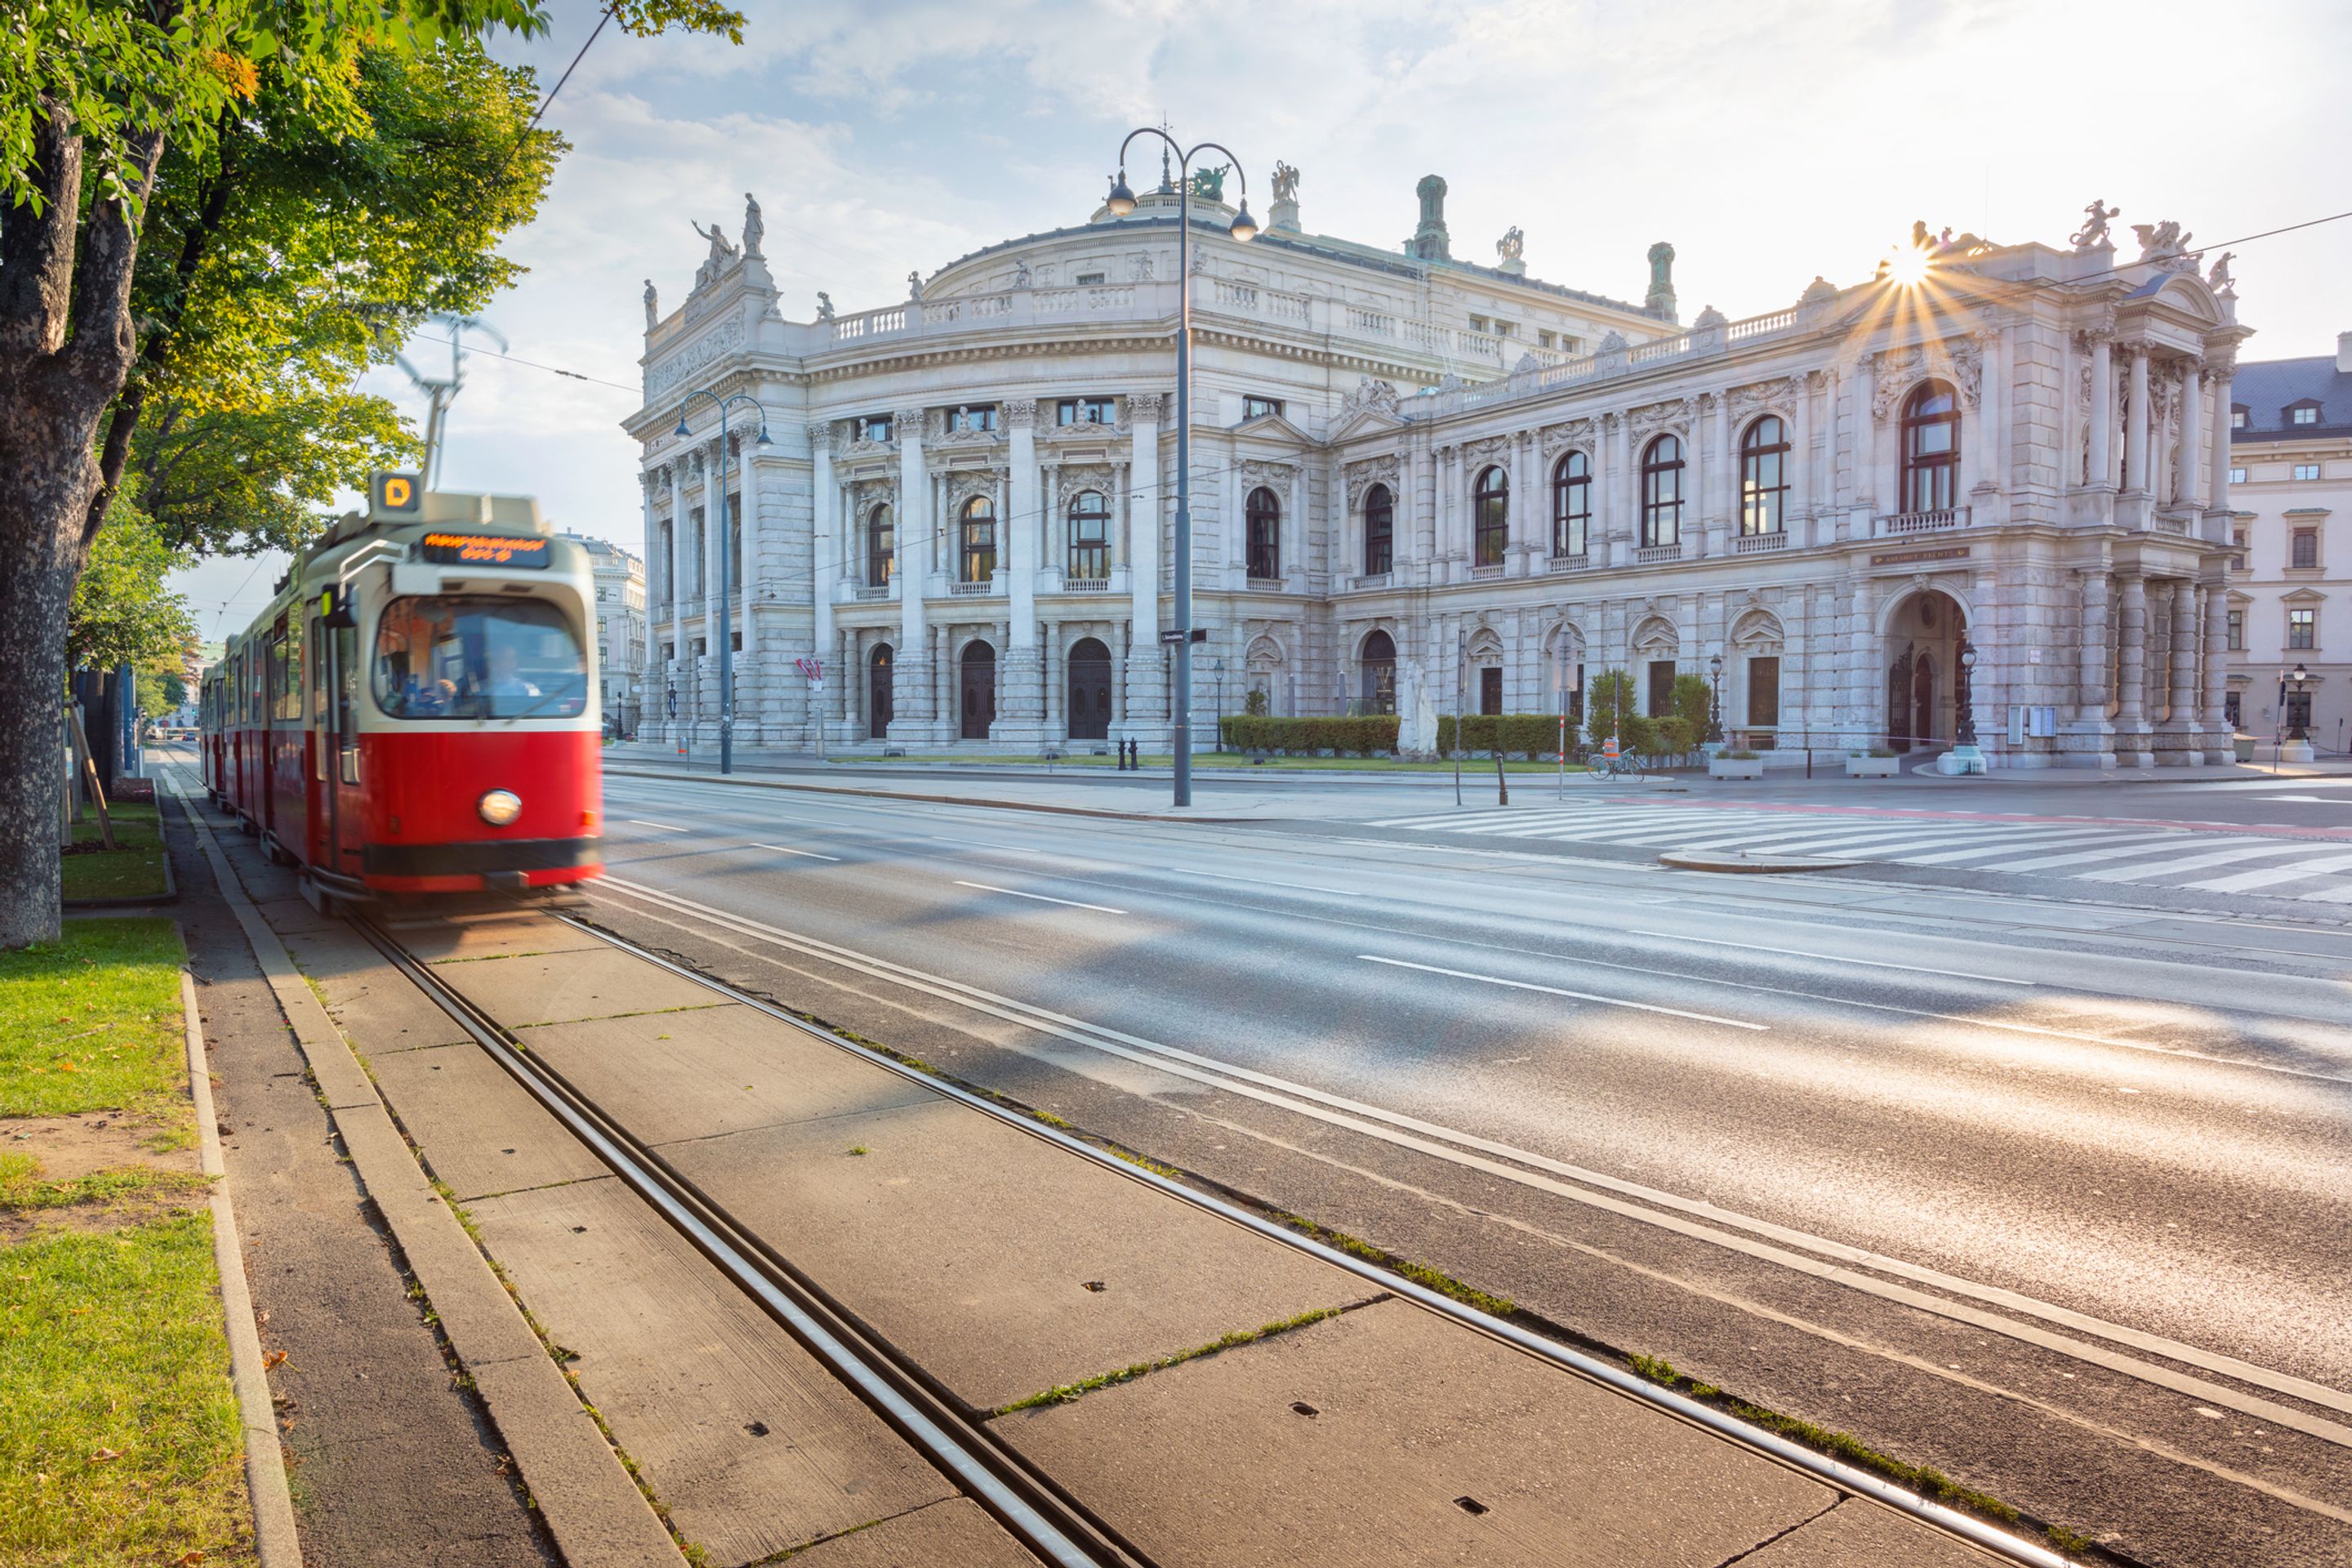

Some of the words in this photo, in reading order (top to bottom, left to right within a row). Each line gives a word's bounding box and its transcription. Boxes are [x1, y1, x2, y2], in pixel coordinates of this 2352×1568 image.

[385, 478, 411, 506] D
[1886, 555, 1918, 563] ANFAHRT
[1923, 550, 1954, 559] RECHTS
